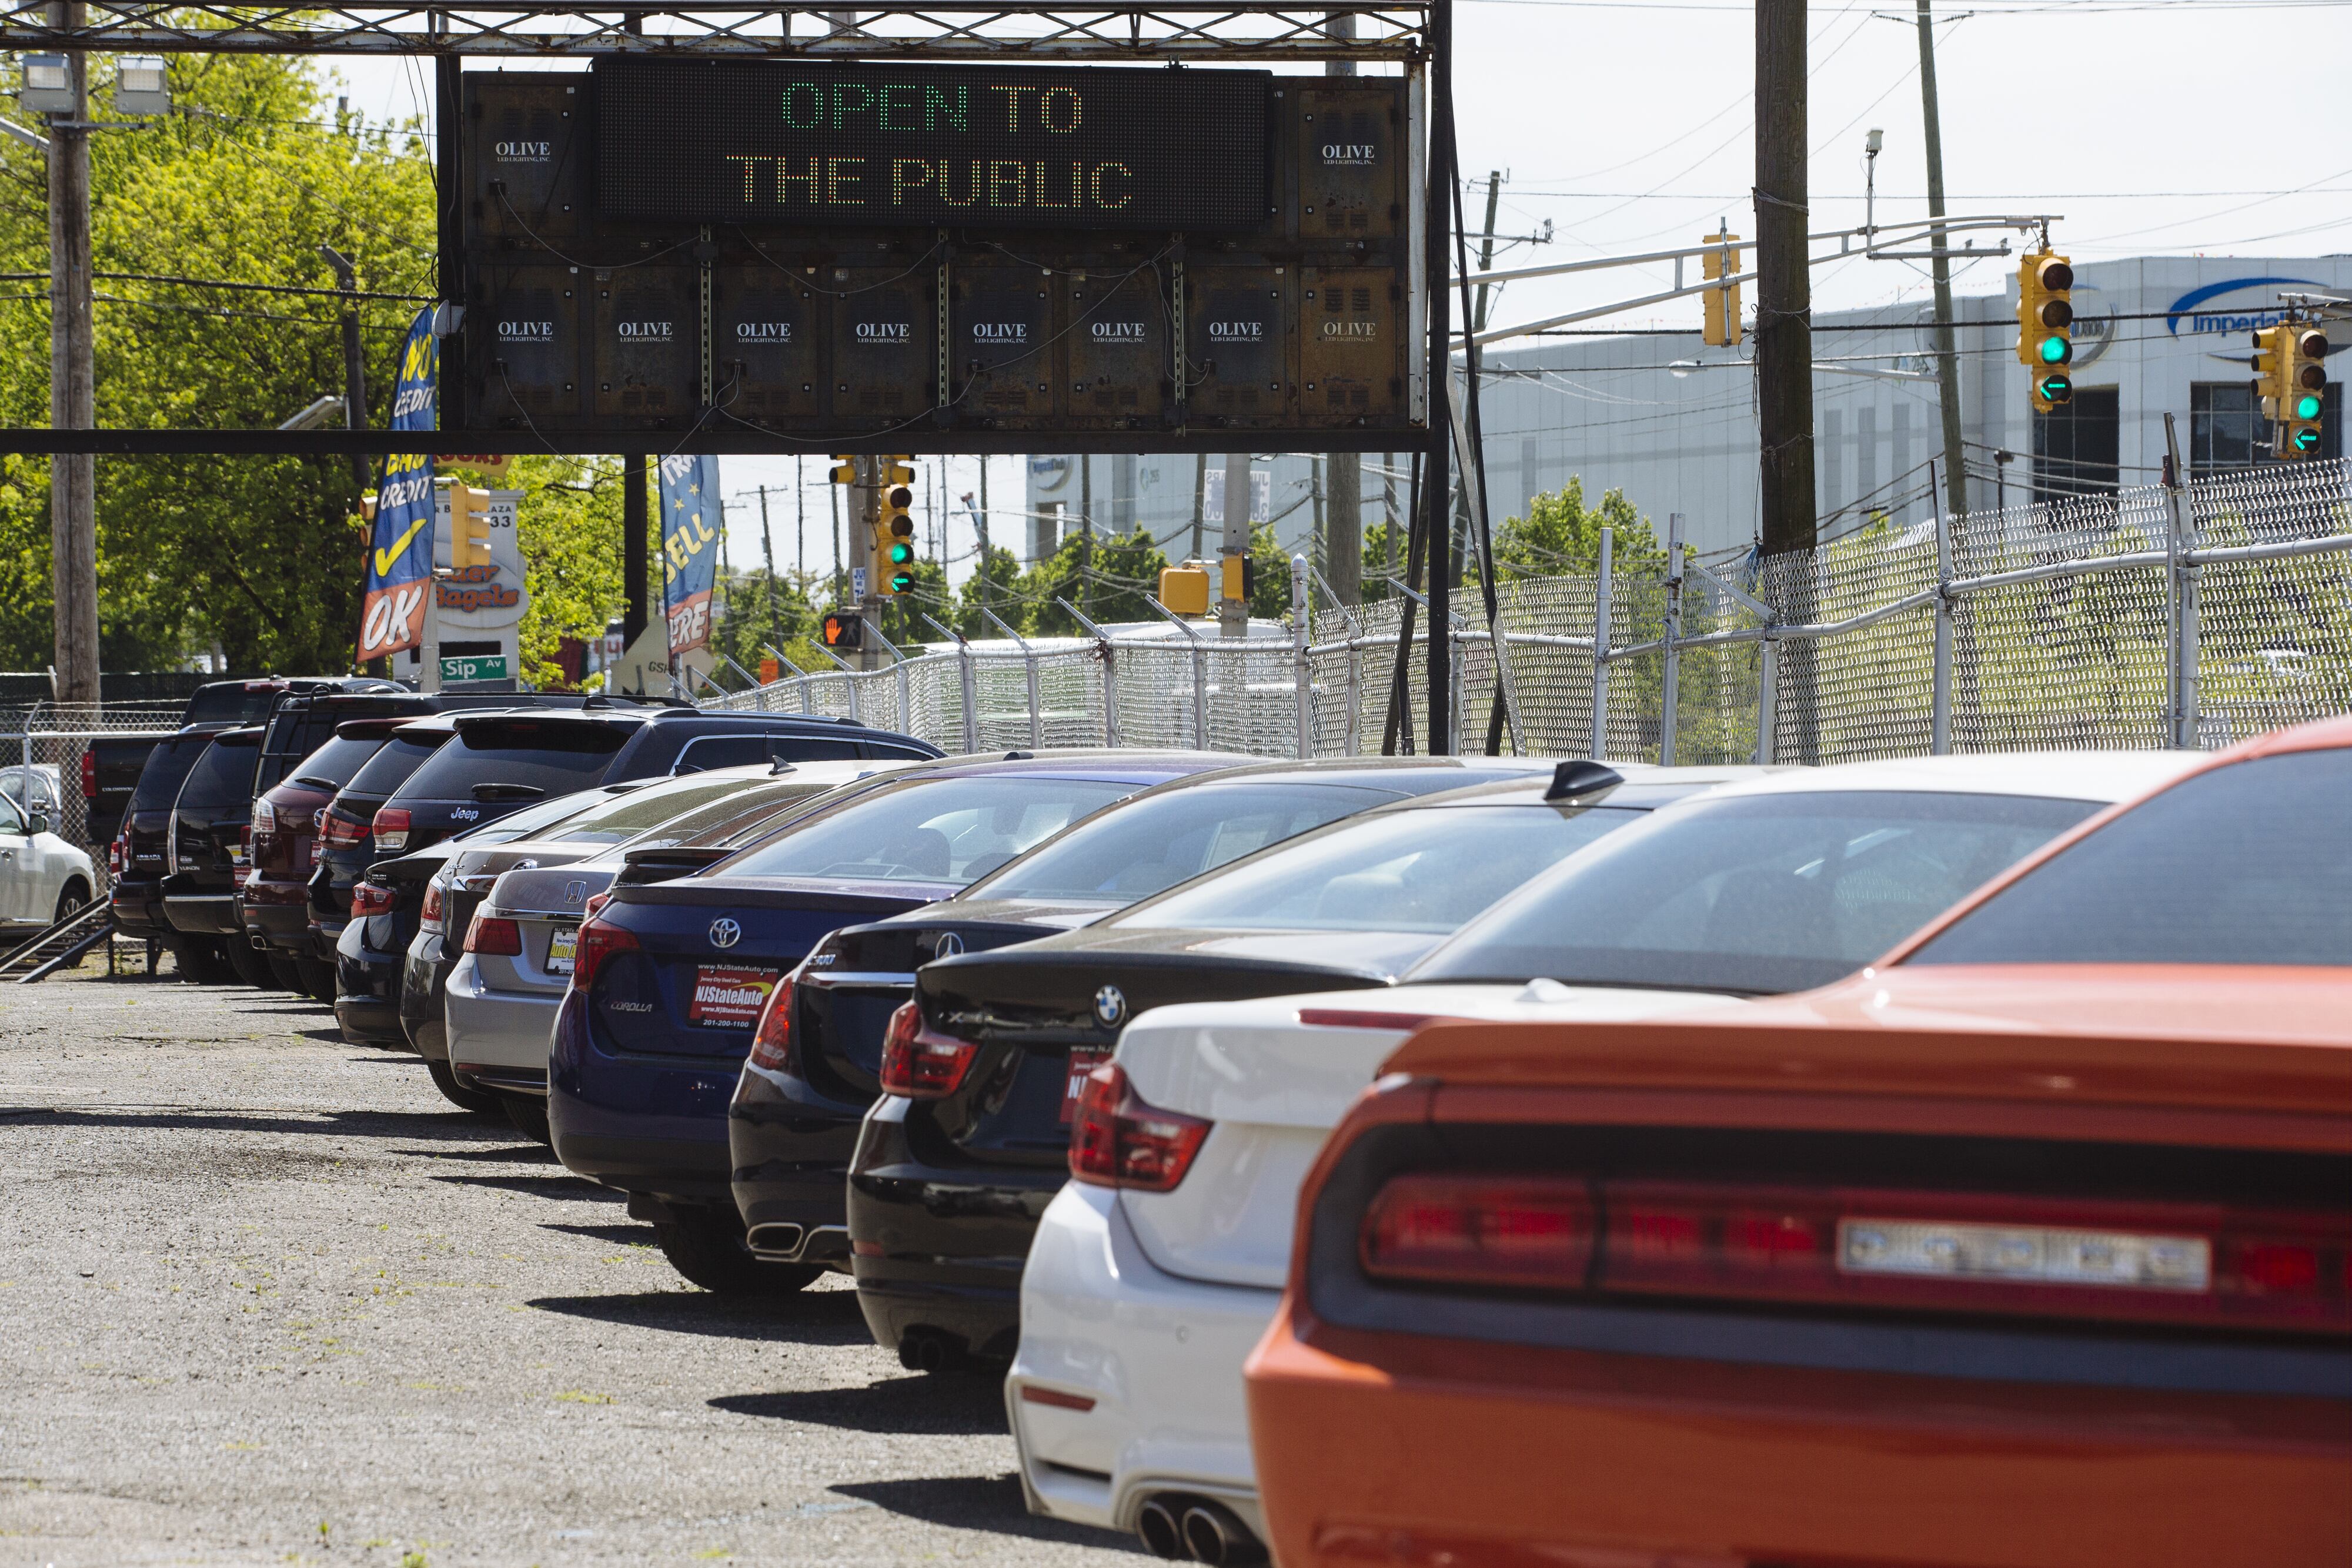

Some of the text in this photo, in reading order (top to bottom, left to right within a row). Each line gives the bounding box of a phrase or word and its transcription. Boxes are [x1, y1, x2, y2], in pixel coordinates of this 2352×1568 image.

[783, 83, 1082, 133] OPEN TO
[495, 142, 550, 156] OLIVE
[1322, 145, 1375, 159] OLIVE
[727, 156, 1132, 209] THE PUBLIC
[497, 322, 552, 336] OLIVE
[618, 322, 673, 336] OLIVE
[736, 323, 791, 337] OLIVE
[856, 323, 910, 337] OLIVE
[973, 323, 1027, 337] OLIVE
[1091, 323, 1146, 337] OLIVE
[1209, 322, 1264, 336] OLIVE
[1324, 322, 1376, 336] OLIVE
[402, 333, 432, 382] NO
[380, 474, 433, 510] CREDIT
[363, 586, 423, 651] OK
[445, 659, 501, 680] Sip Av
[450, 807, 479, 822] Jeep
[550, 942, 570, 958] Auto
[695, 985, 763, 1006] NJStateAuto
[611, 1001, 653, 1012] COROLLA
[703, 1018, 750, 1028] 201-200-1100
